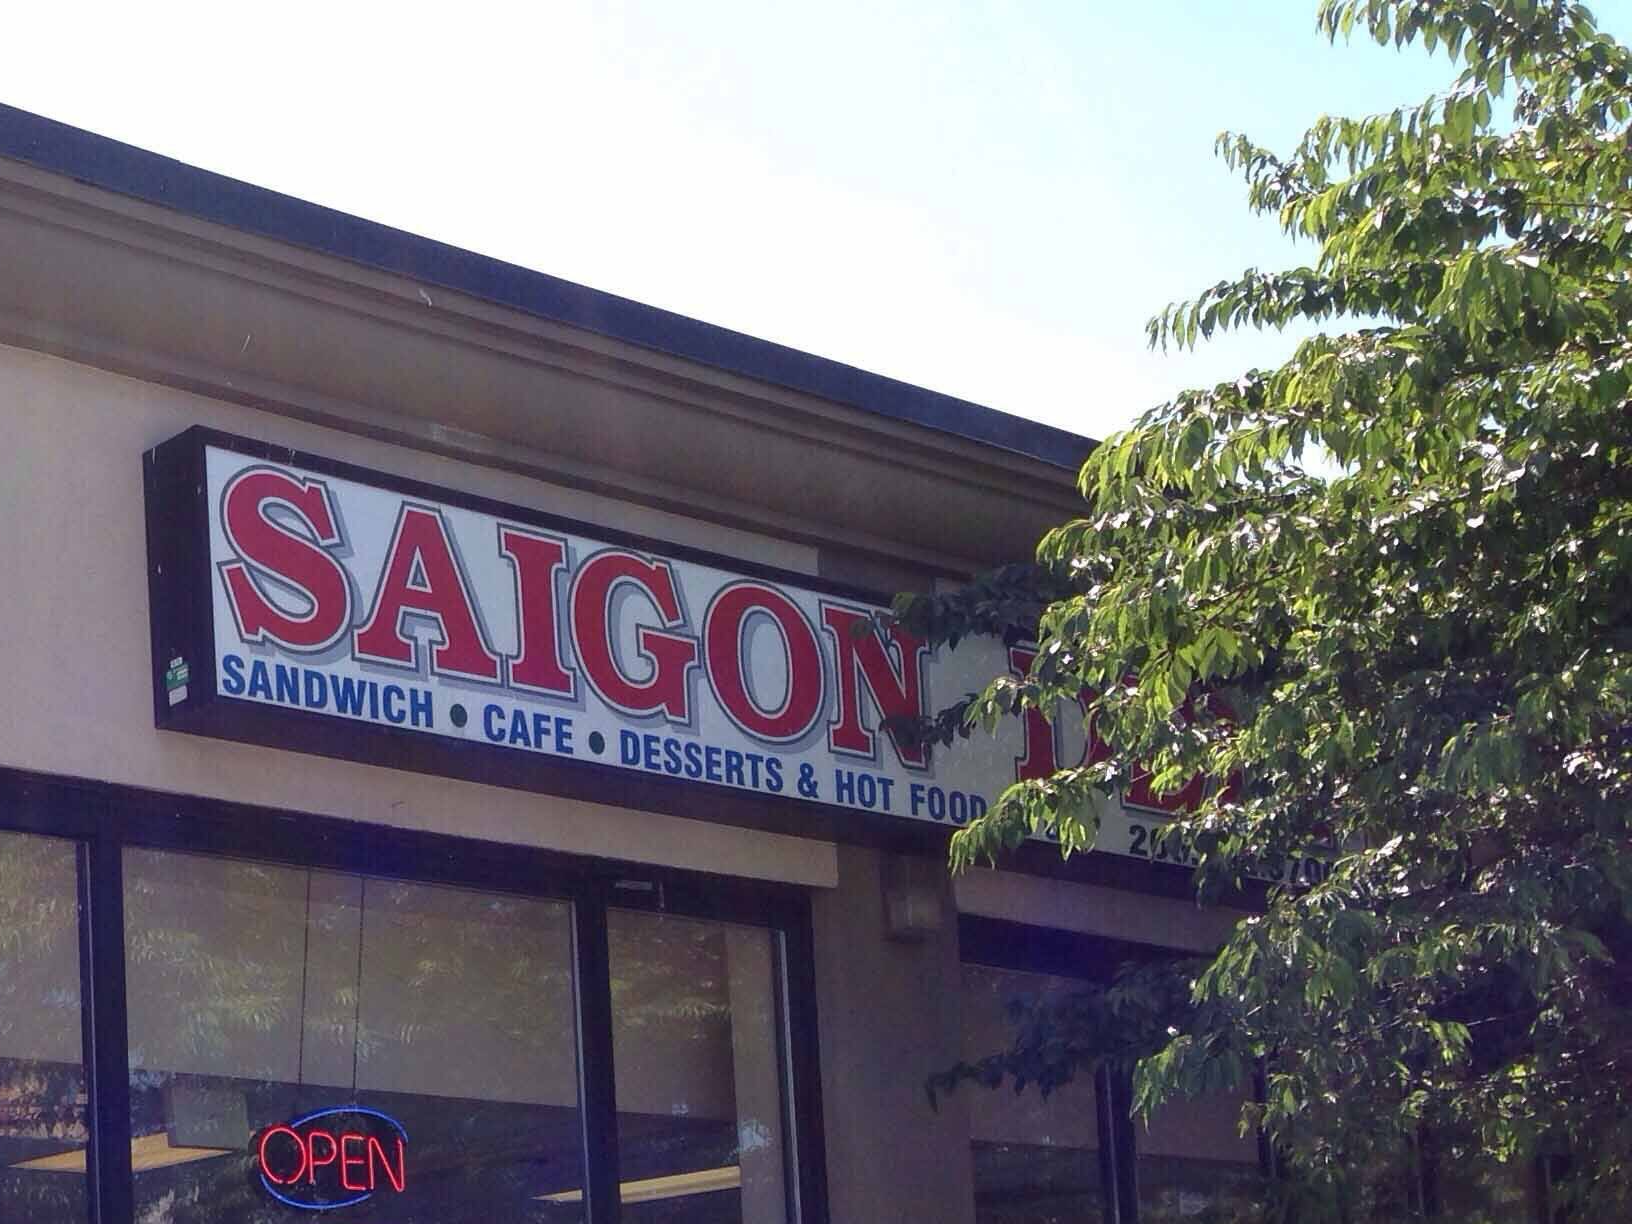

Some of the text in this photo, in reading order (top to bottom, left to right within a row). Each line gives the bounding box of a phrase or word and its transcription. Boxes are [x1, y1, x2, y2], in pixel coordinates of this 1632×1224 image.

[218, 465, 934, 772] SAIGON
[221, 653, 435, 730] SANDWICH
[483, 703, 575, 756] CAFE
[619, 729, 785, 794] DESSERTS
[796, 762, 819, 799] &
[834, 768, 895, 812] HOT
[910, 783, 989, 826] FOOD
[258, 1123, 406, 1193] OPEN
